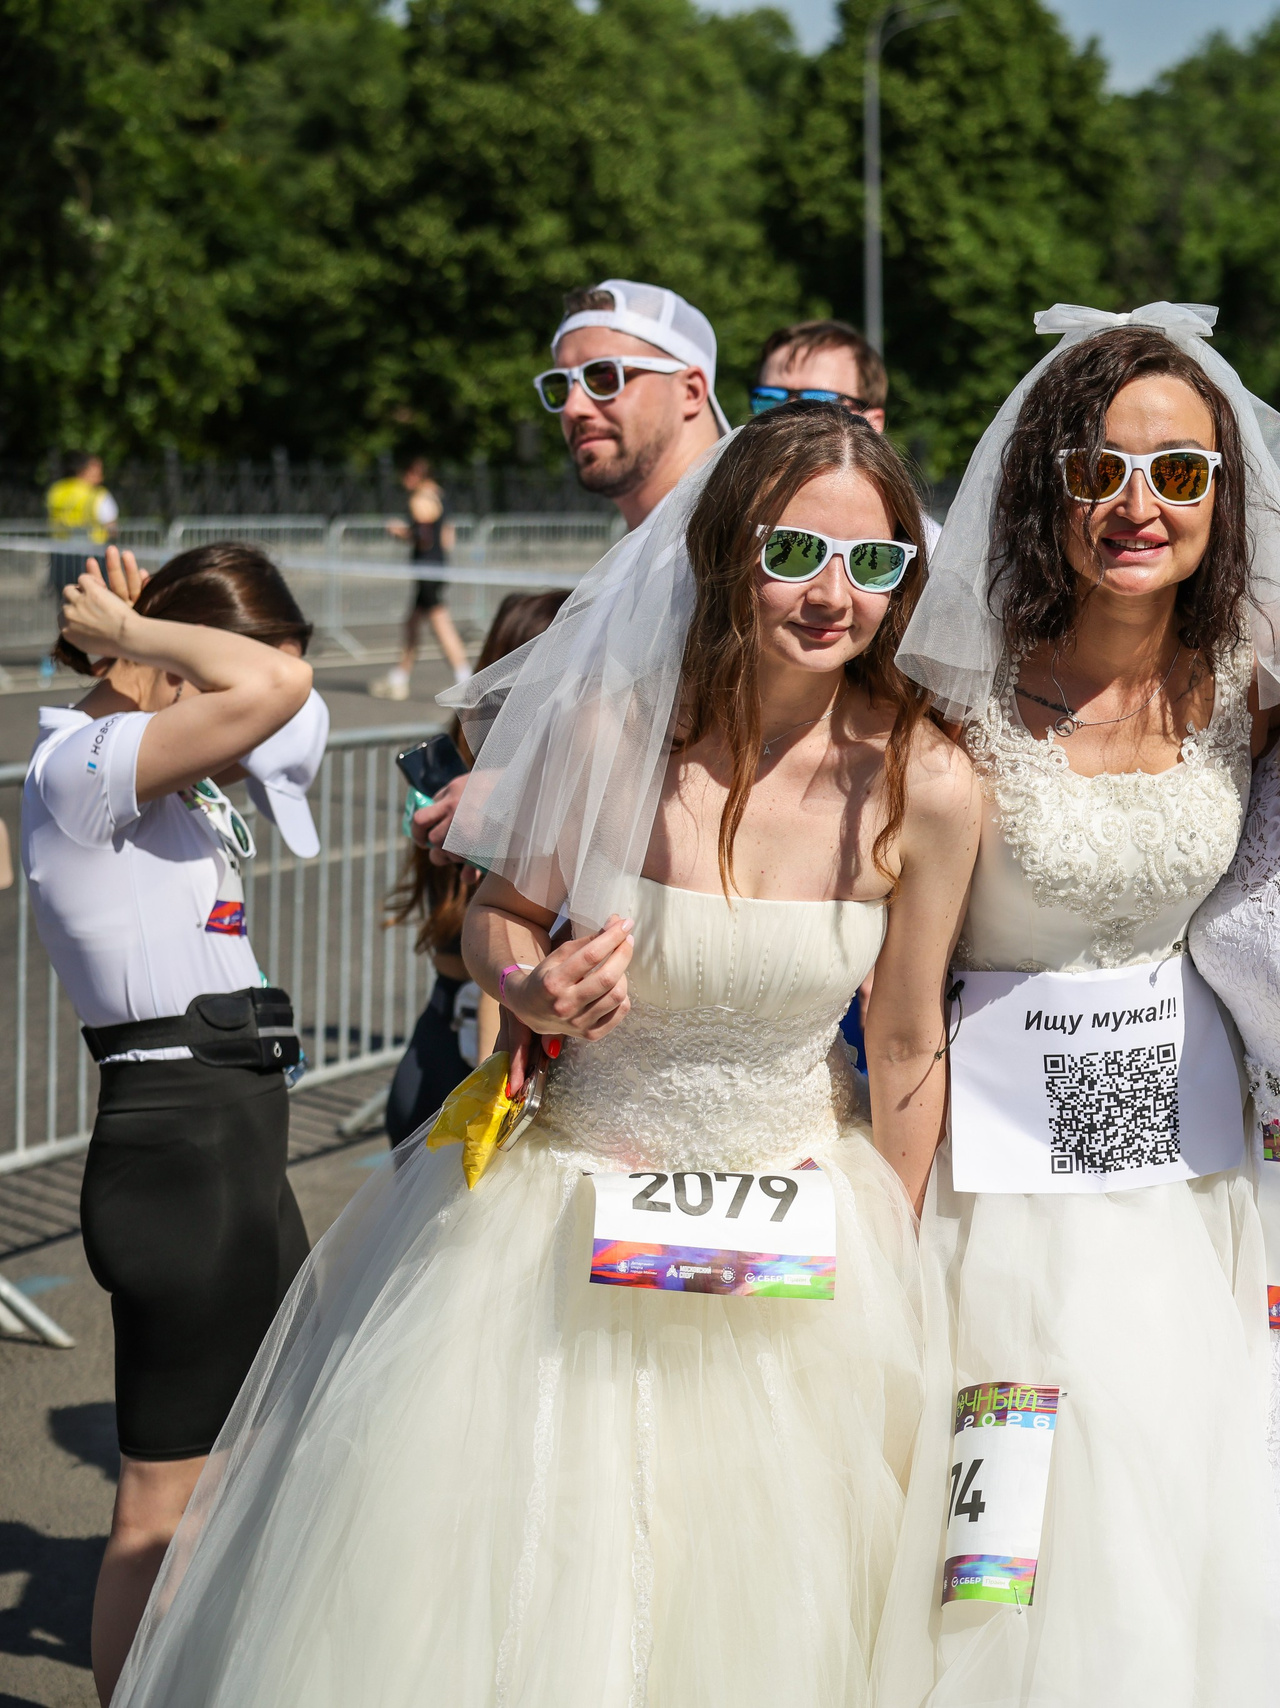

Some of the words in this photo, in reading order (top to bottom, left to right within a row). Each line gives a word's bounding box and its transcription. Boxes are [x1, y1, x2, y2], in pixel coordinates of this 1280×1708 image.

[1024, 1010, 1084, 1035] Ищу
[1091, 997, 1178, 1032] мужа!!!
[628, 1172, 799, 1223] 2079
[757, 1275, 783, 1283] СБЕР
[964, 1412, 1050, 1430] 2026
[959, 1576, 981, 1585] СБЕР
